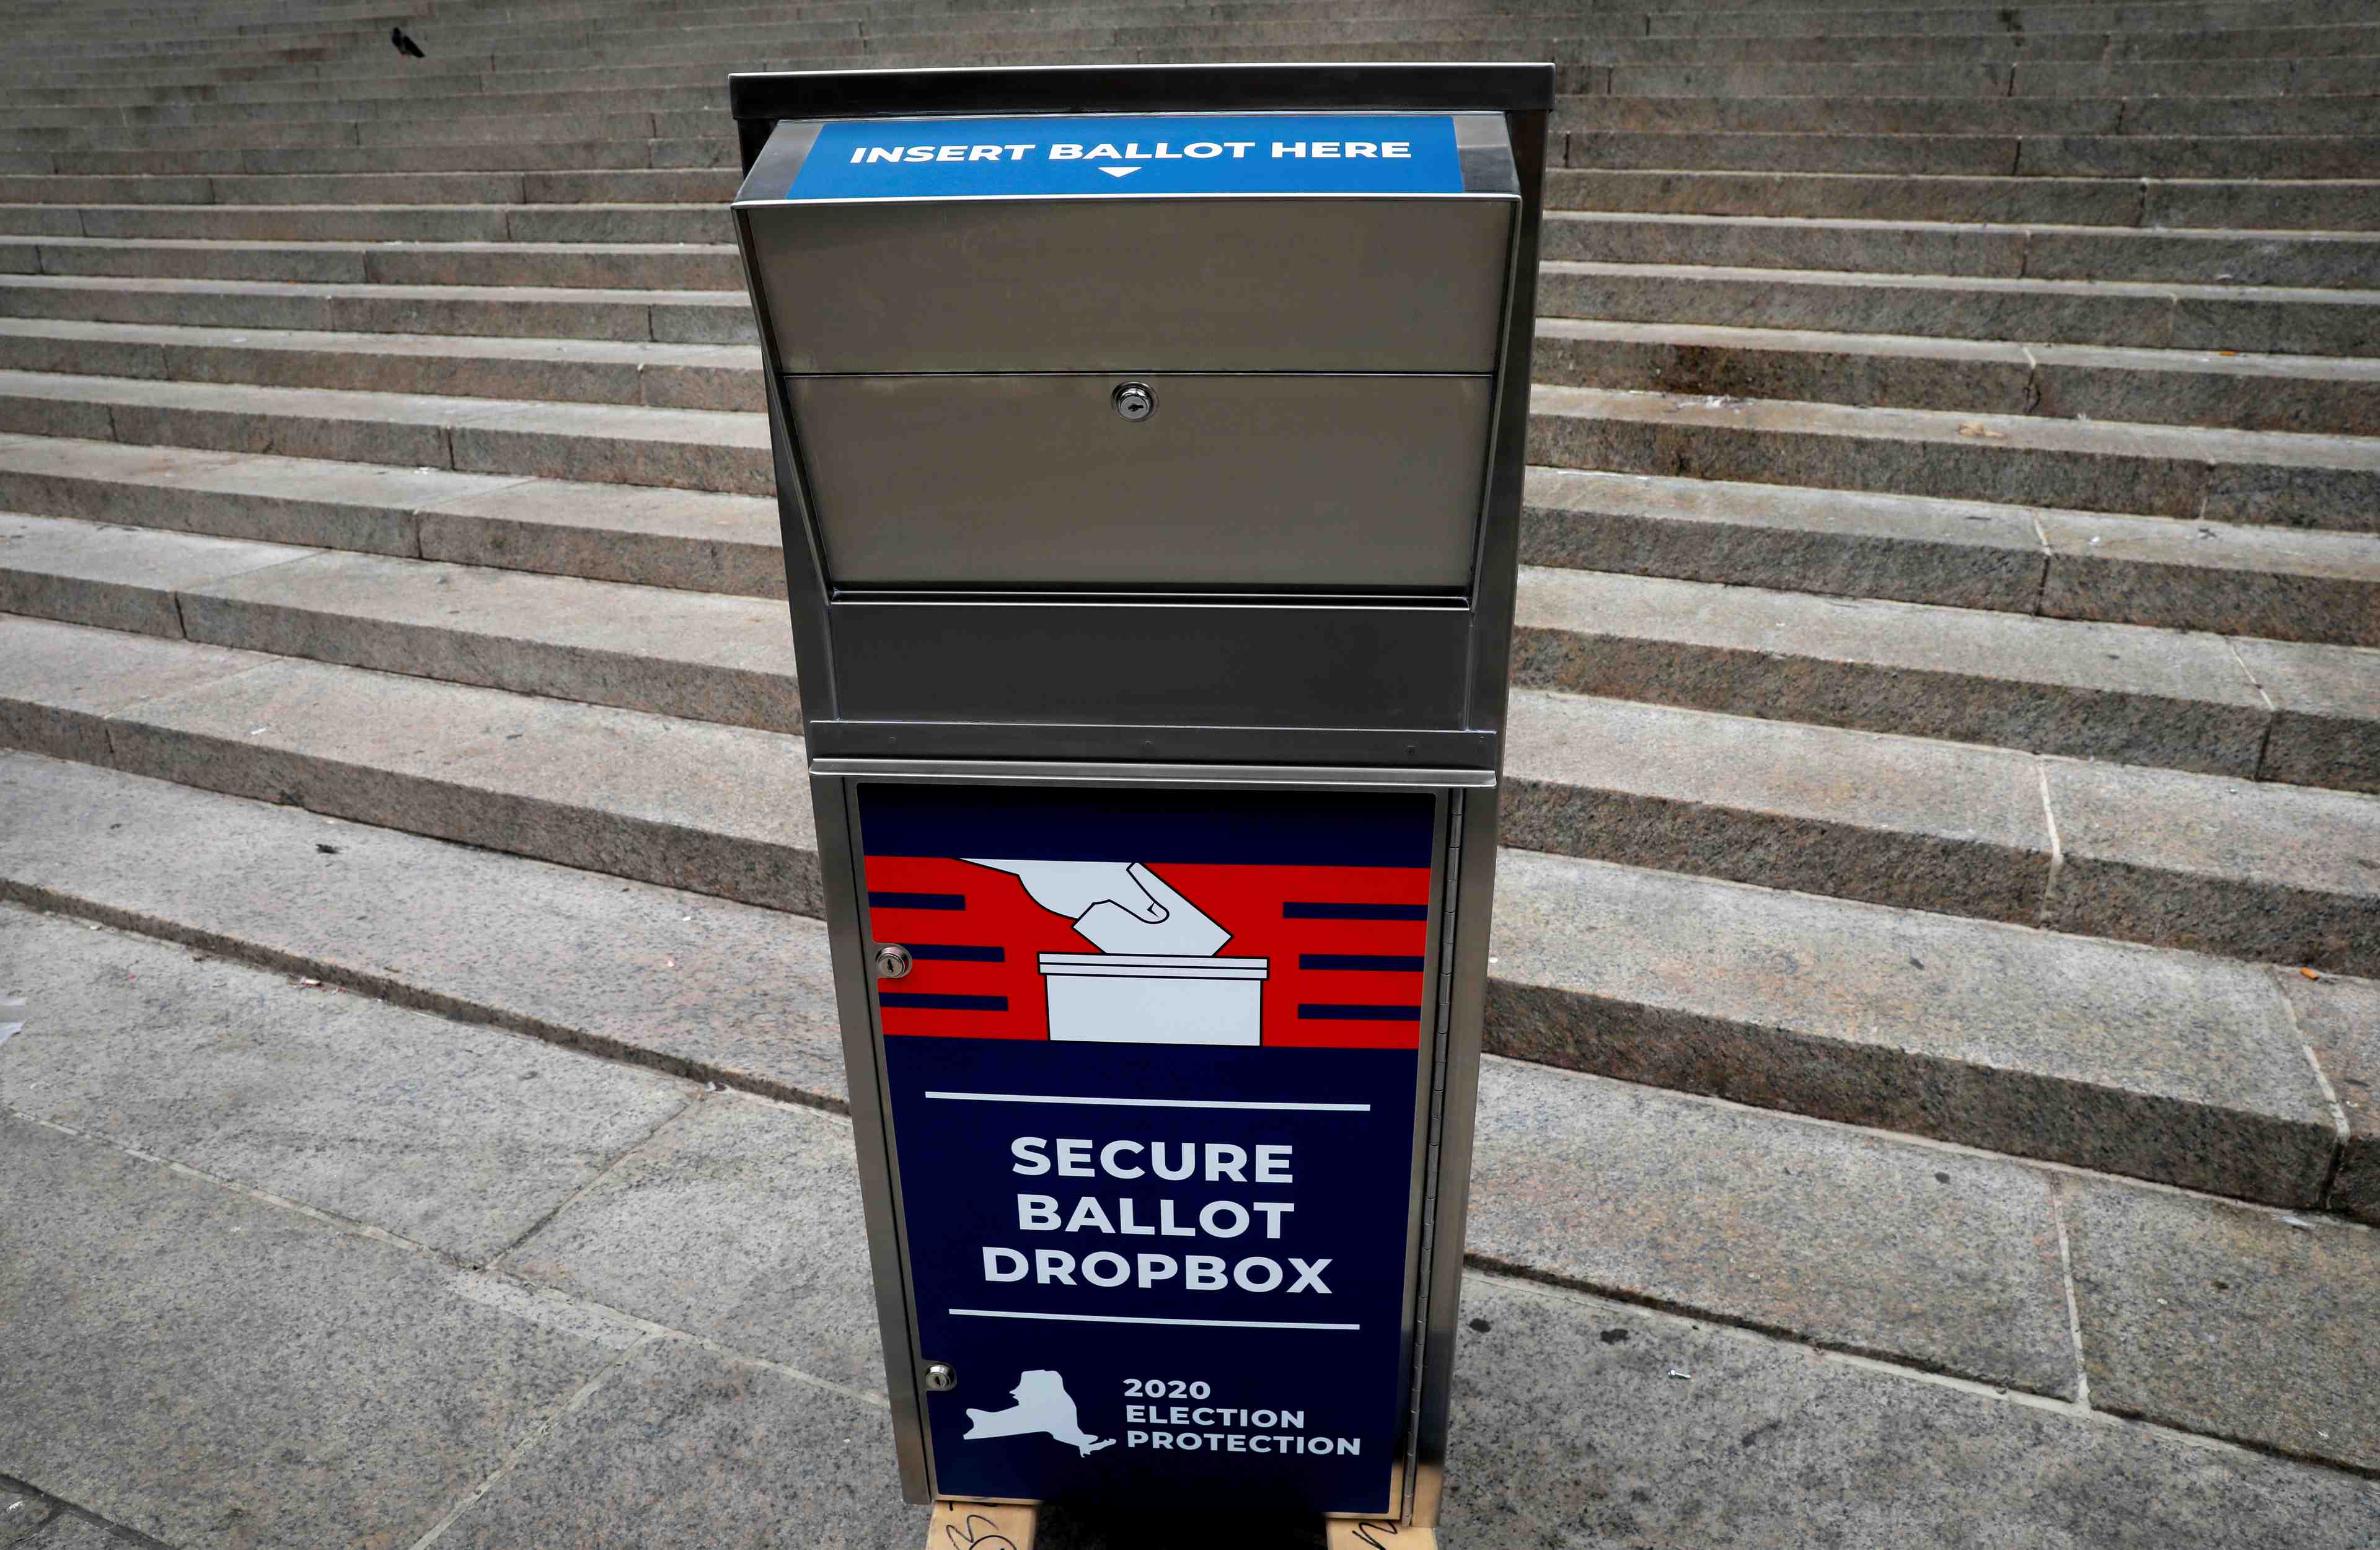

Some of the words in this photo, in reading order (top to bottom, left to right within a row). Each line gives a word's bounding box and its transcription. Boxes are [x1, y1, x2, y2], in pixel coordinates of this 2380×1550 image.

[850, 144, 1036, 164] INSERT
[1048, 142, 1256, 160] BALLOT
[1271, 141, 1411, 158] HERE
[1011, 1137, 1293, 1183] SECURE
[1017, 1194, 1295, 1239] BALLOT
[982, 1246, 1333, 1294] DROPBOX
[1123, 1378, 1210, 1399] 2020
[1126, 1405, 1304, 1429] ELECTION
[1127, 1430, 1360, 1455] PROTECTION
